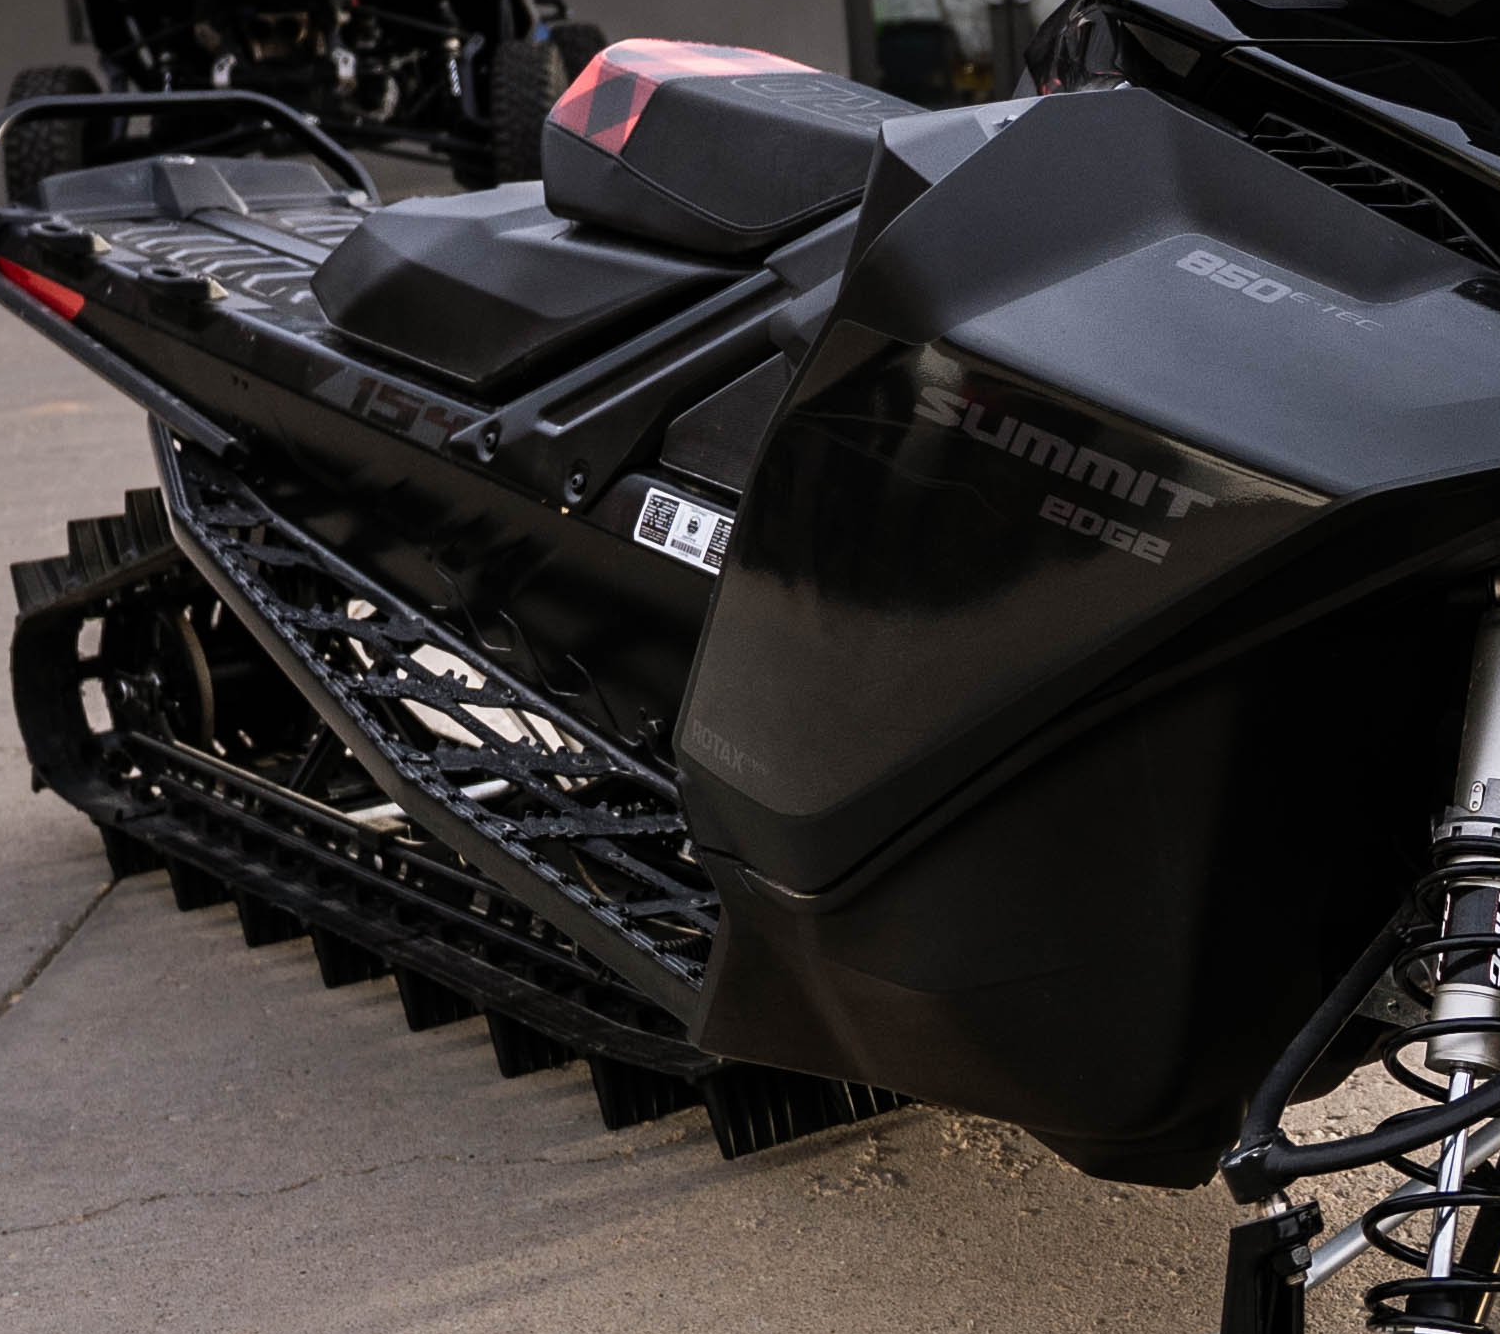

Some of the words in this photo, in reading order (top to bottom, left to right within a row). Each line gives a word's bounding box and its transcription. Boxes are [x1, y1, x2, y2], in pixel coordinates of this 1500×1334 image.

[1175, 250, 1292, 304] 850
[350, 377, 474, 451] 154
[913, 386, 1216, 519] SUMMIT
[691, 717, 745, 775] ROTAX
